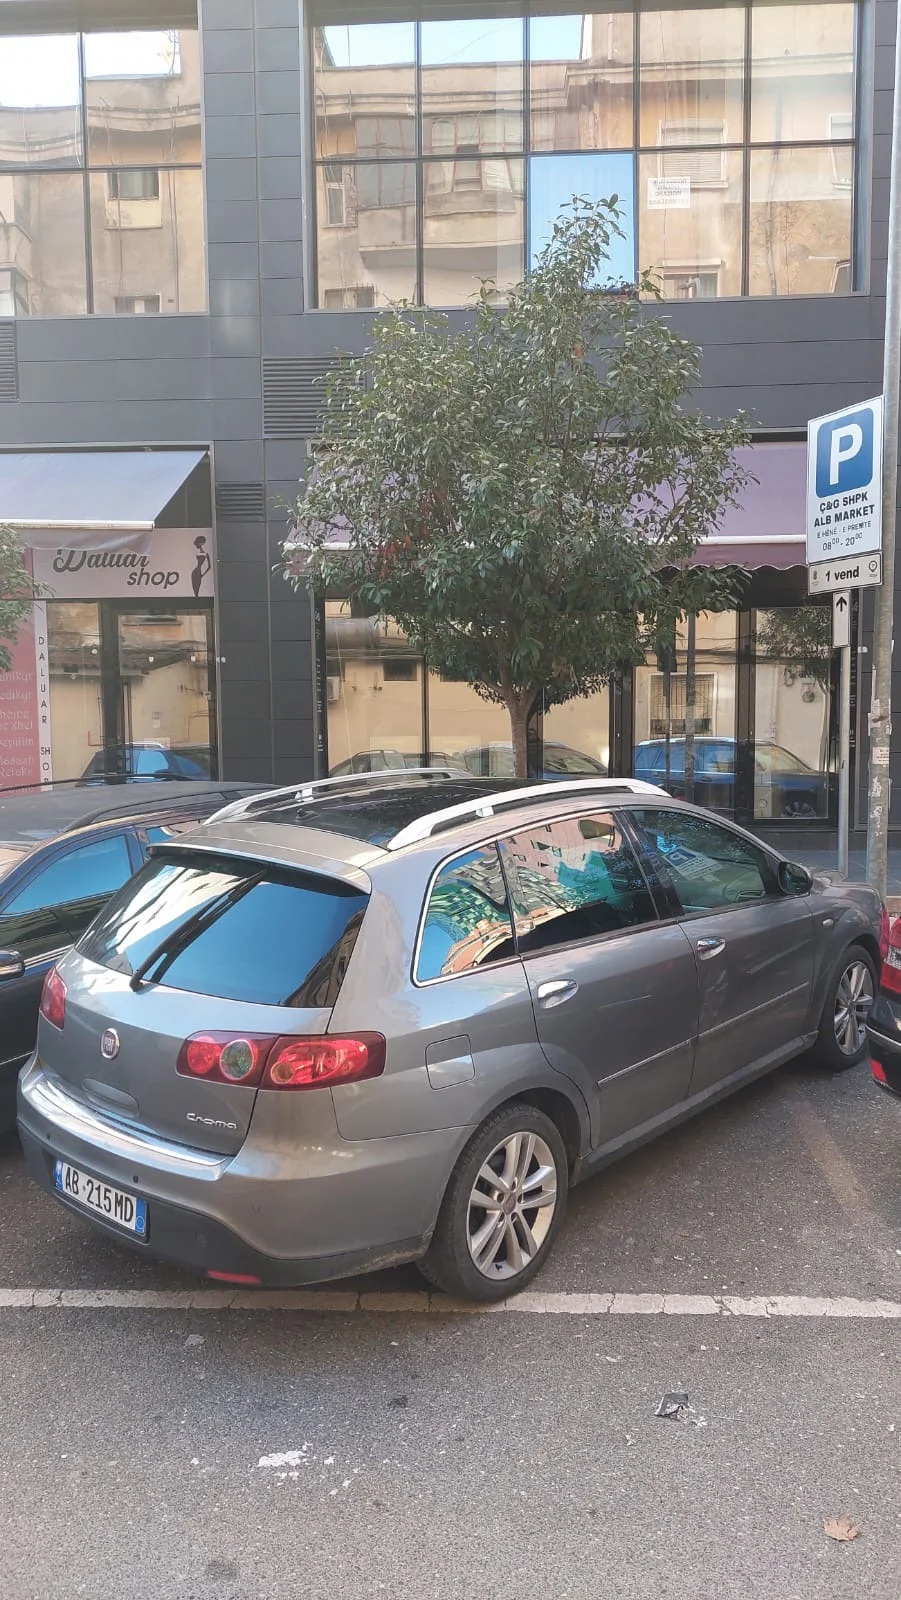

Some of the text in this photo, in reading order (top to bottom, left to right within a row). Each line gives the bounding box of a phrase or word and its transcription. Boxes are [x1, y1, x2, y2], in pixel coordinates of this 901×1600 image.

[829, 423, 863, 486] P
[820, 491, 868, 514] Ç&G SHPK
[814, 504, 875, 528] ALB MARKET
[126, 568, 180, 589] shop
[825, 566, 860, 582] 1 vend
[187, 1112, 237, 1129] Croma
